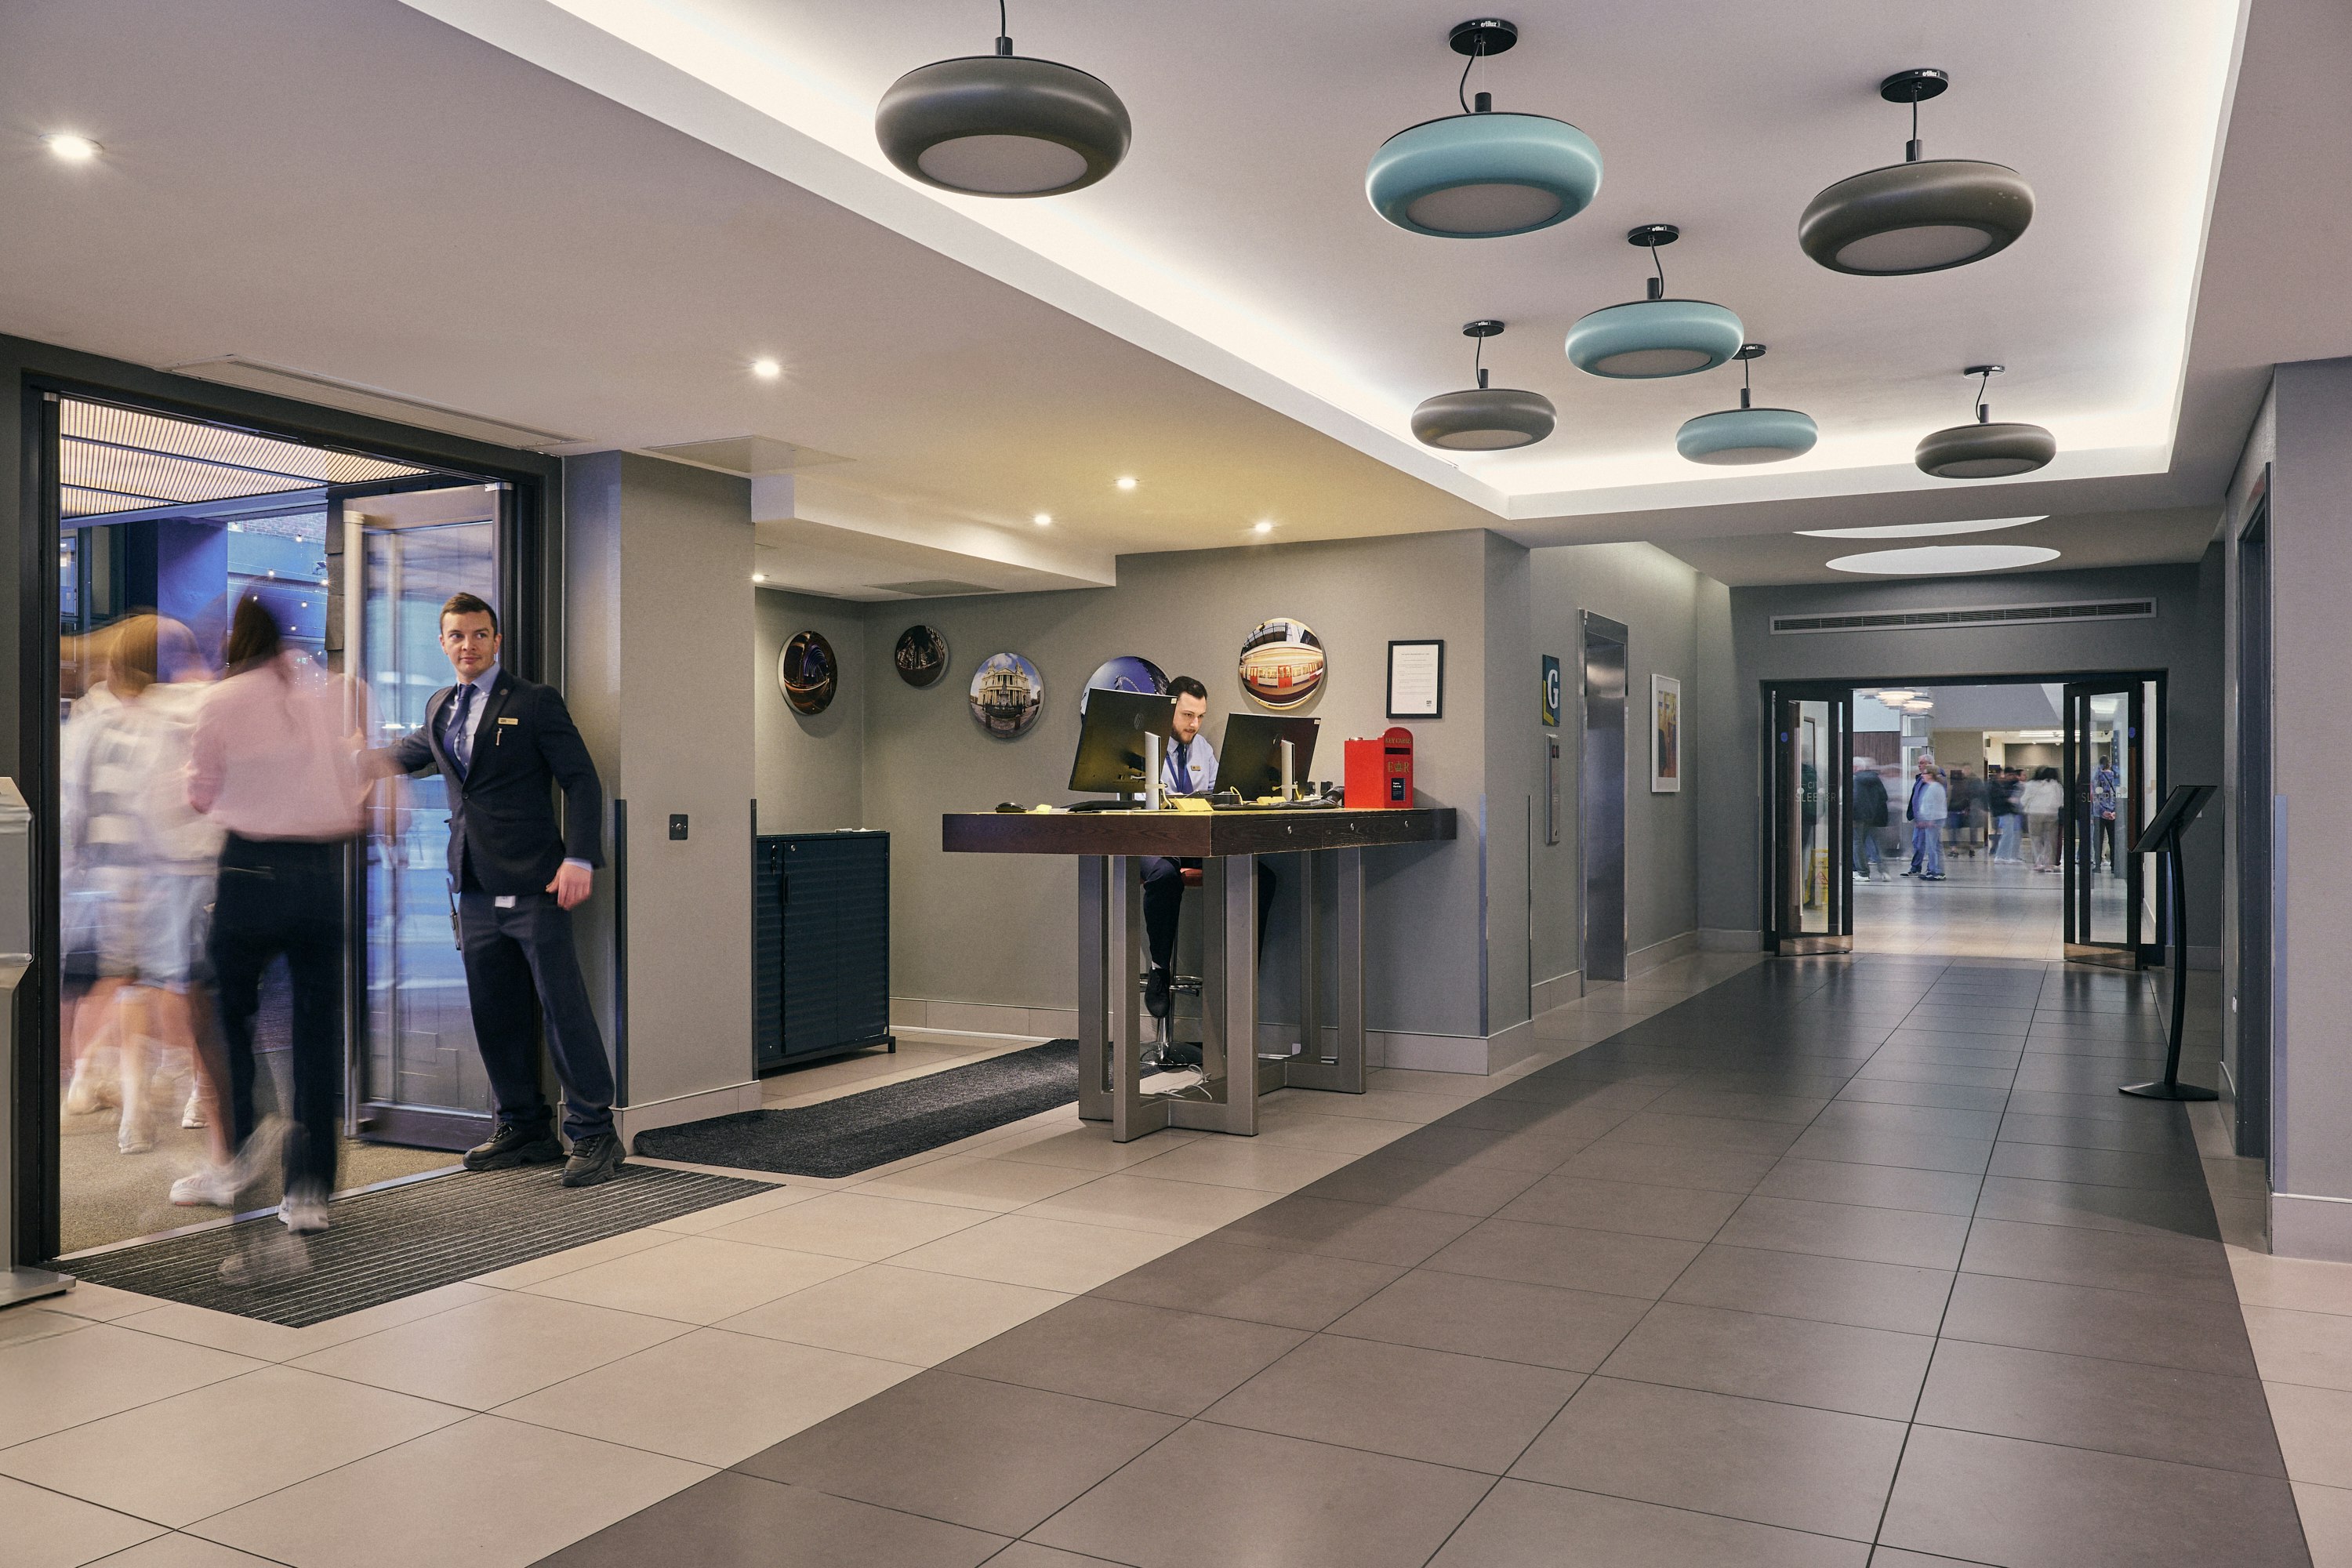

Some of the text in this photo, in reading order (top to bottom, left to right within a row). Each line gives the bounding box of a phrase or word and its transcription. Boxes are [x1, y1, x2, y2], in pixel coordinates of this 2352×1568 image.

[1547, 669, 1559, 710] G
[1388, 761, 1410, 773] E R
[1795, 792, 1836, 802] SLEEER
[2082, 792, 2122, 803] SLEEPR
